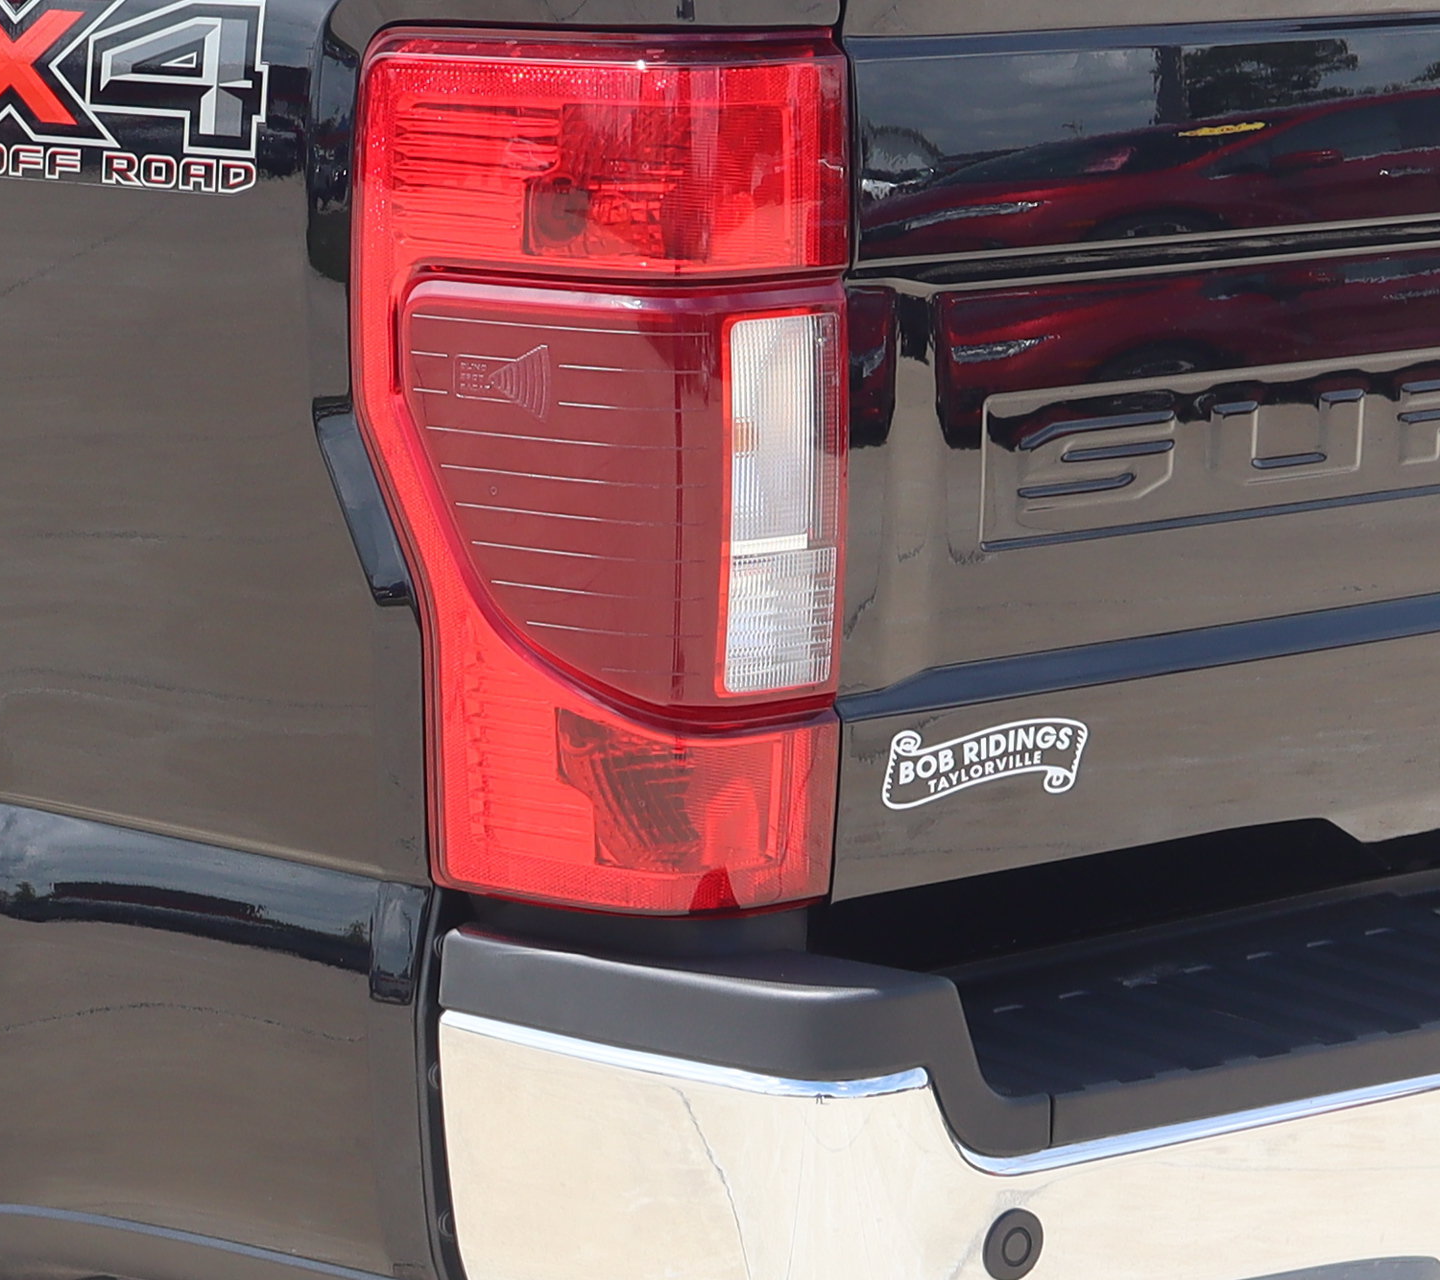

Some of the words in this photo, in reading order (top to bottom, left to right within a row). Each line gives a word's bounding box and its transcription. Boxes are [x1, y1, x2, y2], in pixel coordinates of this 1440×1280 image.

[101, 150, 257, 195] ROAD
[899, 749, 955, 785] BOB
[963, 726, 1073, 765] RIDINGS
[927, 750, 1043, 794] TAYLORVILLE
